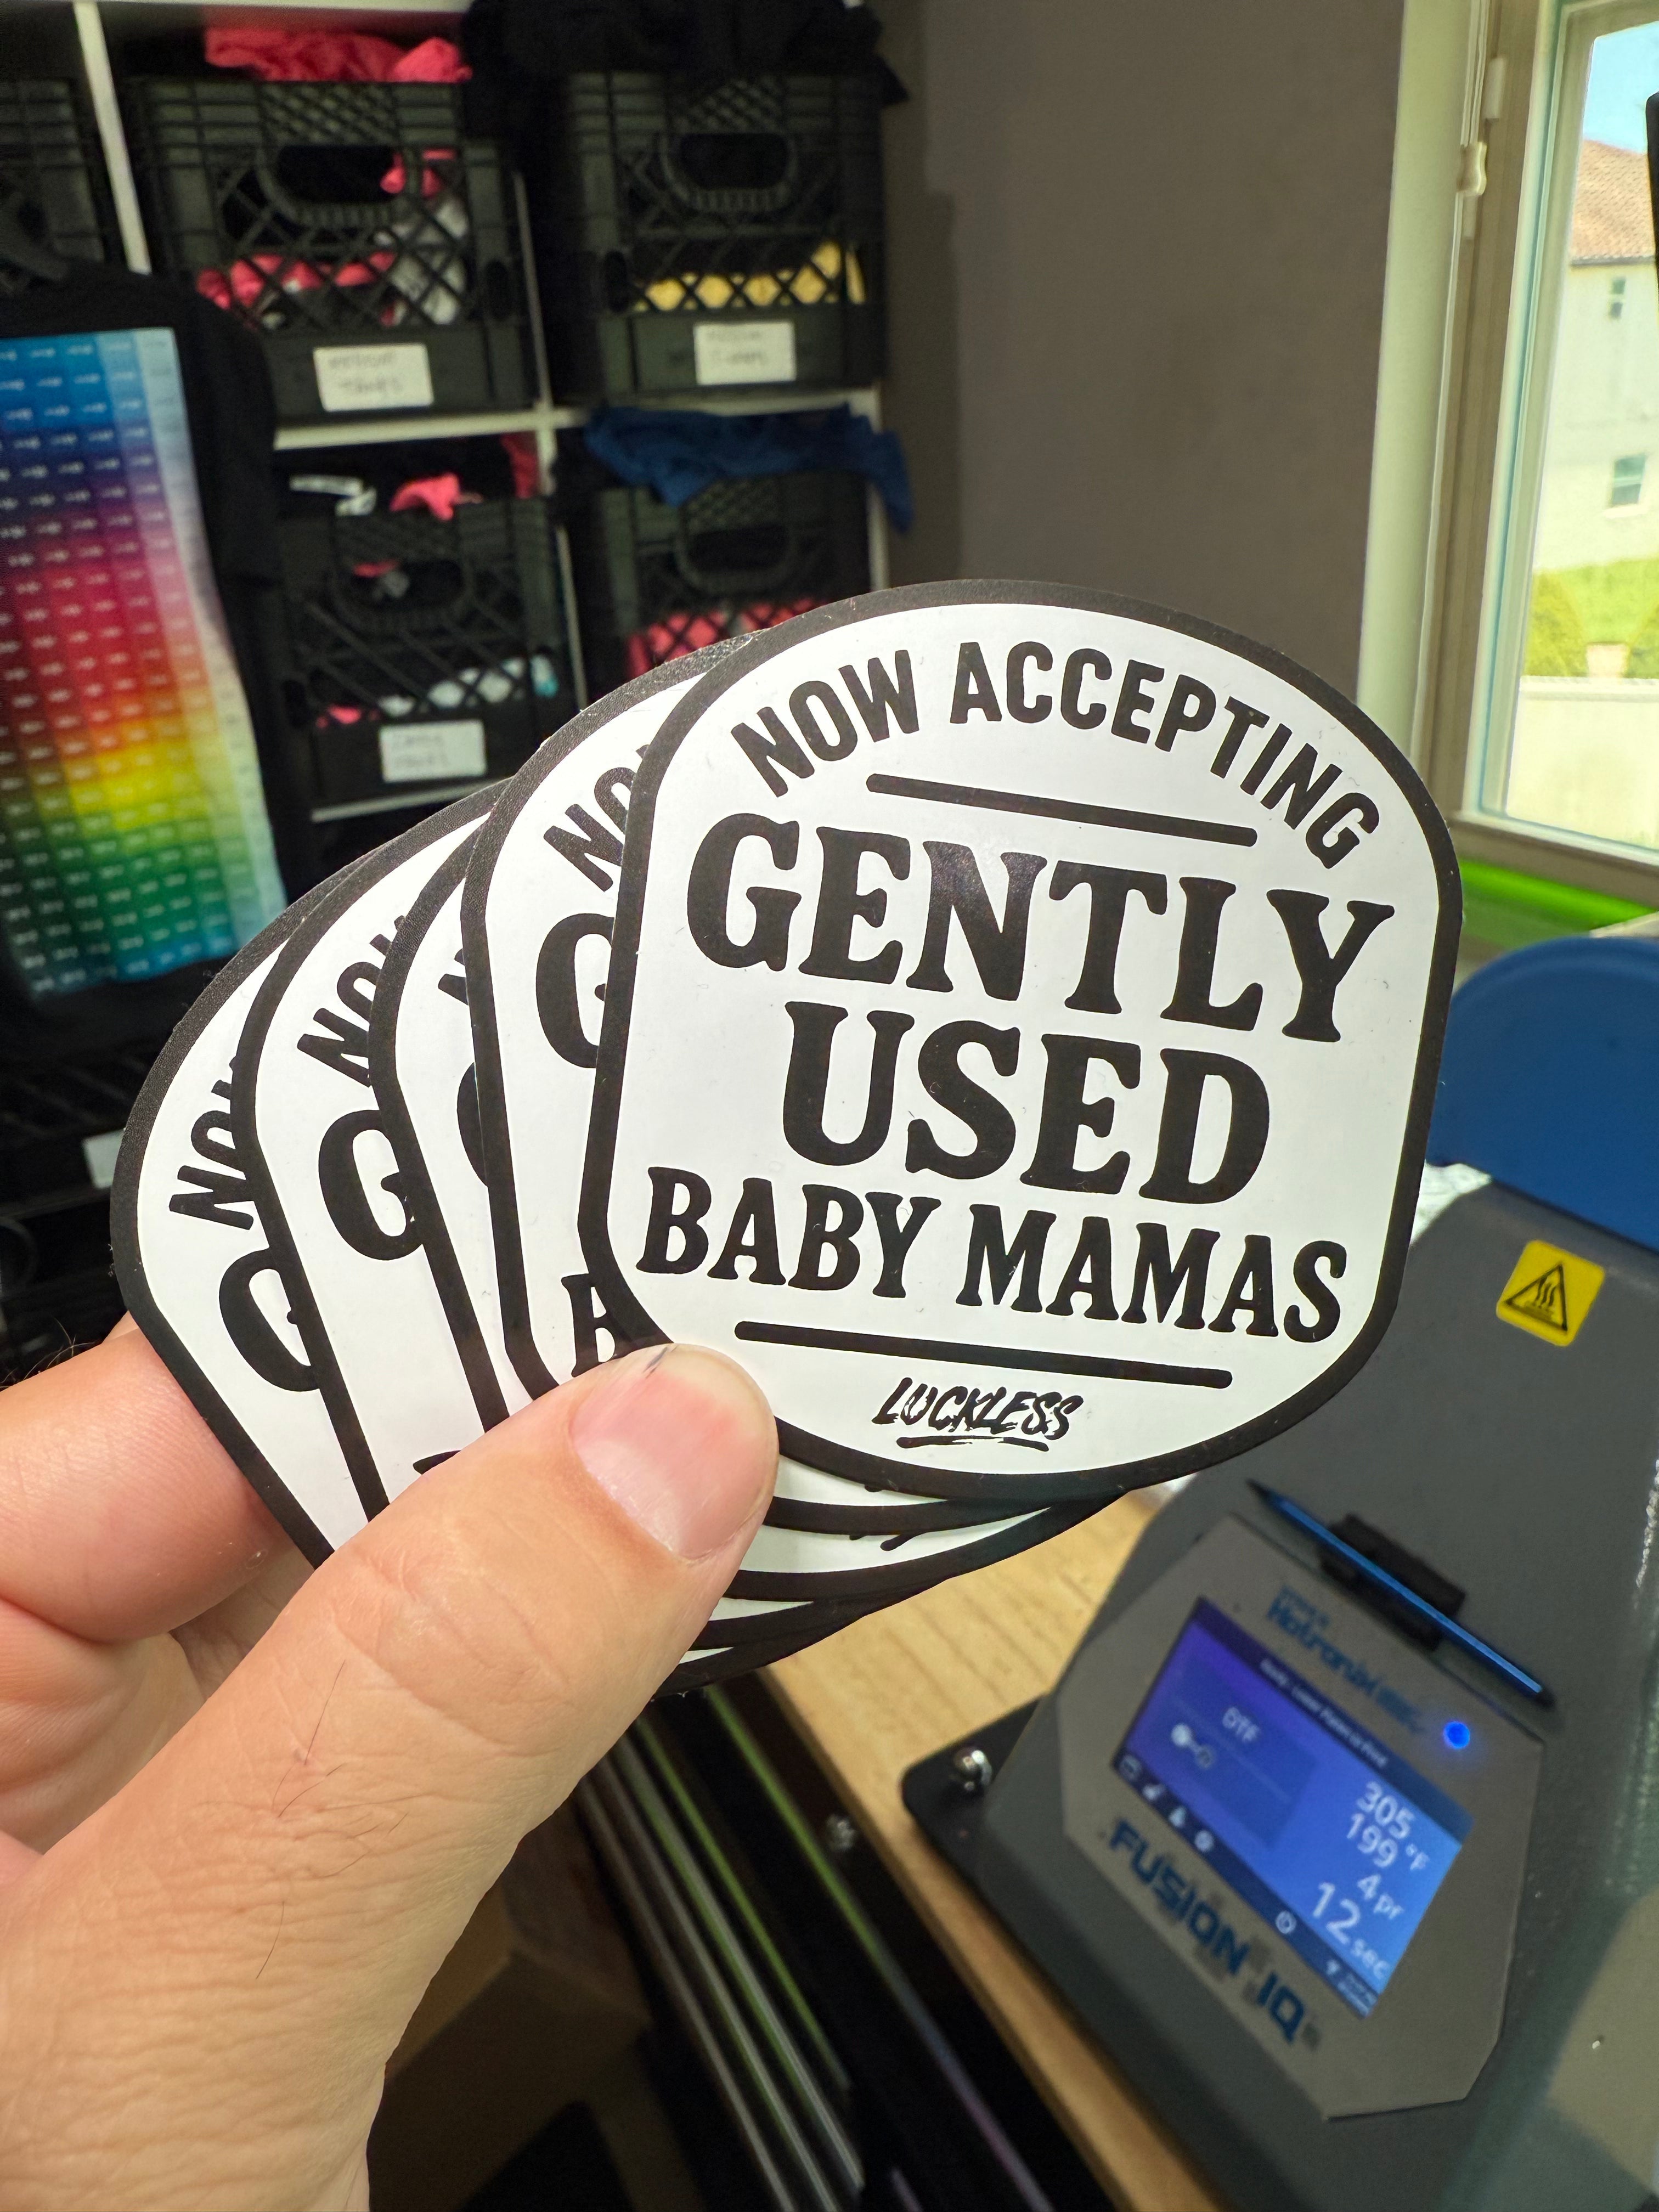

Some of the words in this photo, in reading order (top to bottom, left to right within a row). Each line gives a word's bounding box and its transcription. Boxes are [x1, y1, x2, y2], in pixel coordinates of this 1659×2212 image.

[543, 744, 651, 892] NO
[731, 650, 919, 798] NOW
[950, 641, 1380, 870] ACCEPTING
[297, 915, 407, 1087] NO
[687, 812, 1395, 1043] GENTLY
[169, 1056, 255, 1230] NO
[783, 1001, 1270, 1204] USED
[635, 1166, 942, 1299] BABY
[955, 1204, 1347, 1343] MAMAS
[871, 1377, 1084, 1441] LUCKLESS
[1346, 1812, 1398, 1867] 199
[1356, 1781, 1415, 1839] 305
[1356, 1874, 1381, 1900] 4
[1109, 1817, 1251, 1977] FUSION
[1256, 1972, 1305, 2045] IQ
[1313, 1882, 1361, 1946] 12
[1351, 1938, 1390, 1979] sec
